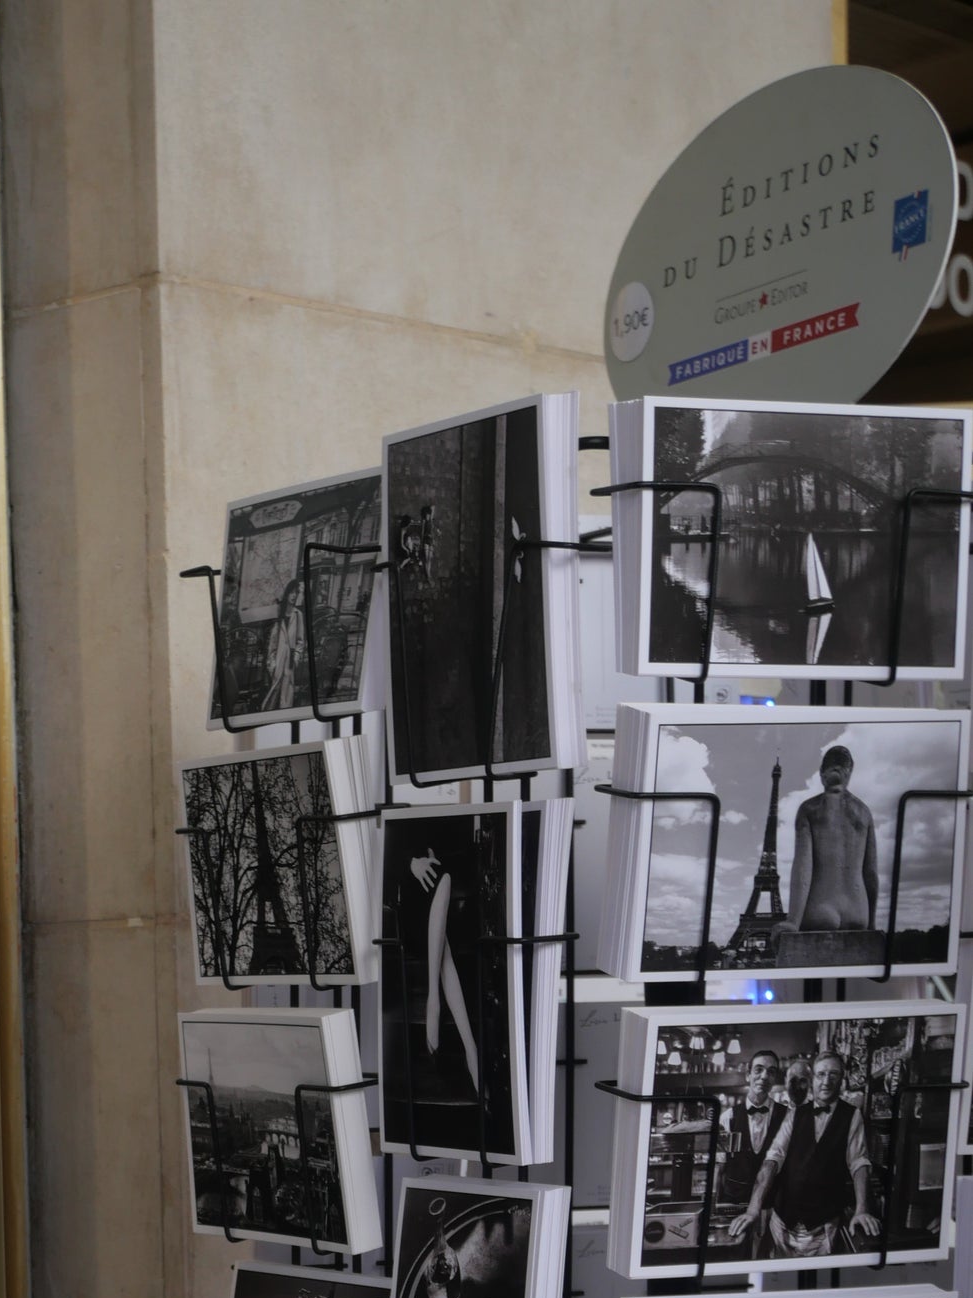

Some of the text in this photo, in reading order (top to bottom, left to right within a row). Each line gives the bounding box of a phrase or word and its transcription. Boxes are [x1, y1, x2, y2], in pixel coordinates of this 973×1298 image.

[719, 133, 880, 217] ÉDITIONS
[662, 257, 698, 288] DU
[717, 190, 876, 268] DÉSASTRE
[613, 307, 650, 338] 1,90€
[713, 281, 809, 325] GROUPE EDITOR
[674, 312, 847, 380] FABRIQUÉ EN FRANCE
